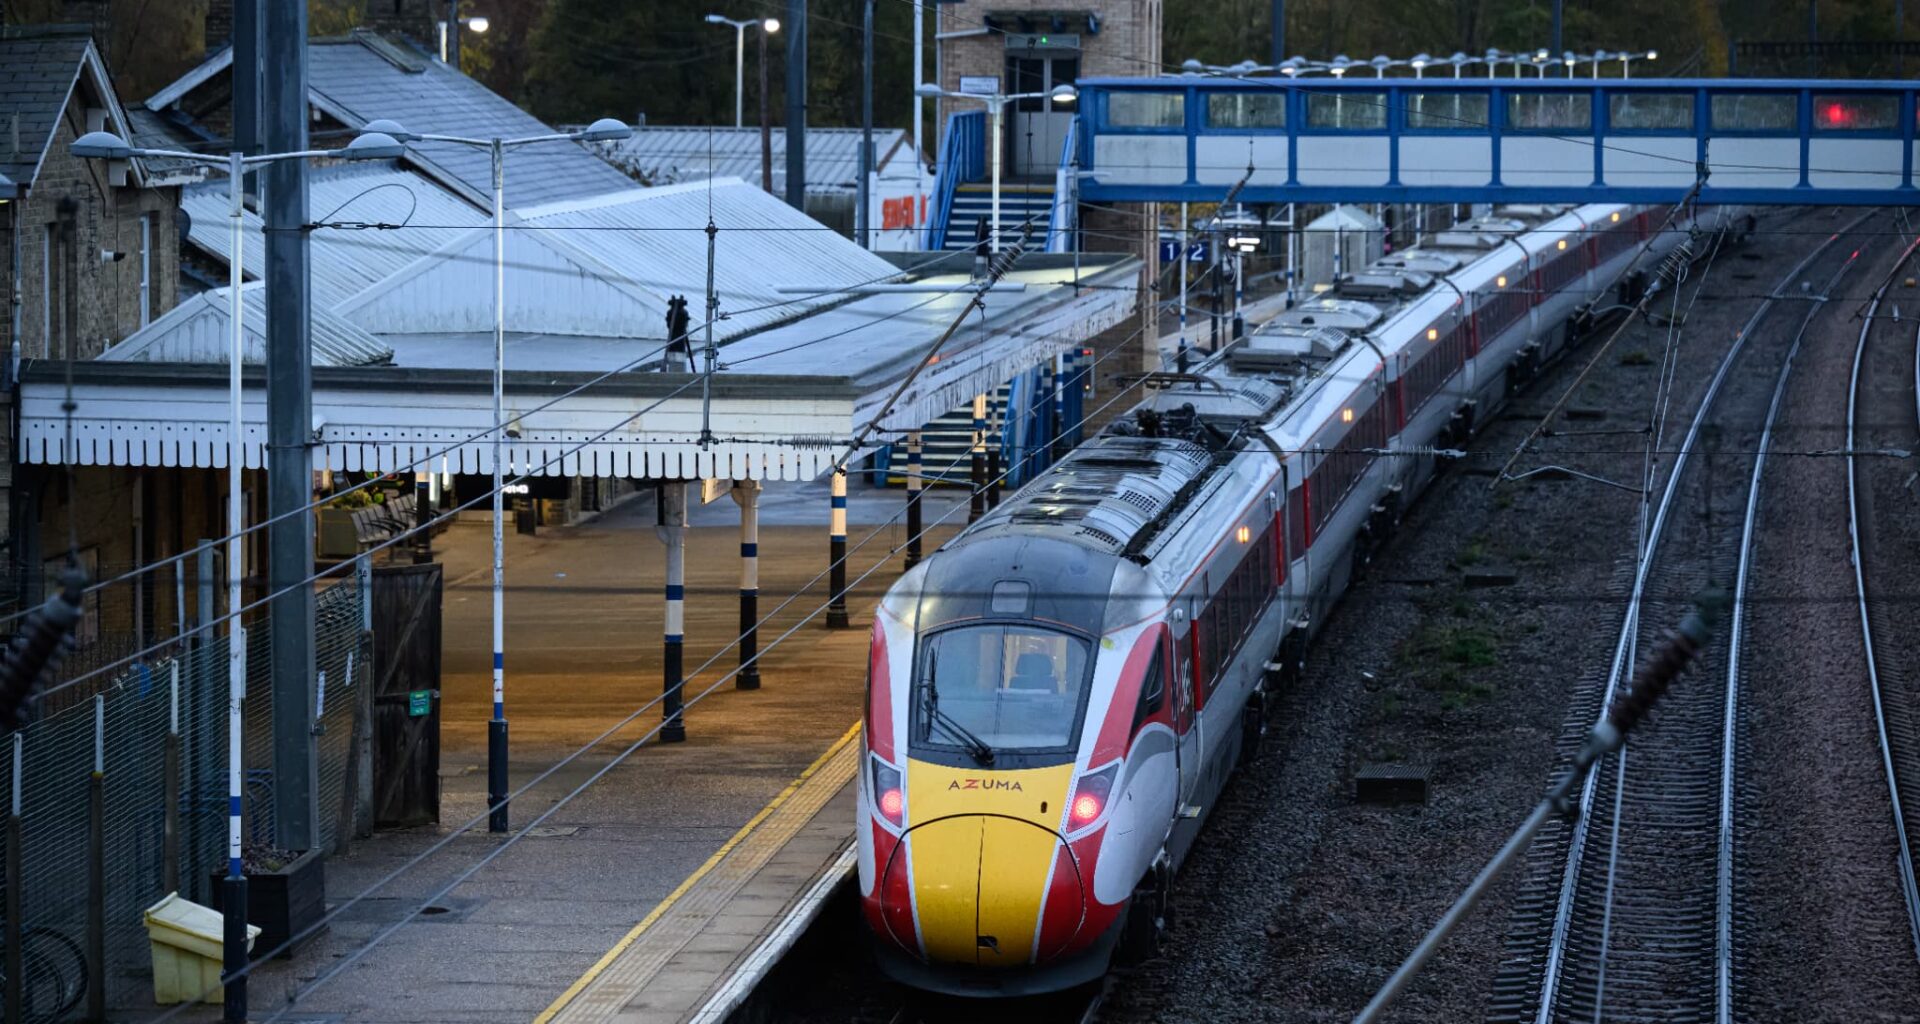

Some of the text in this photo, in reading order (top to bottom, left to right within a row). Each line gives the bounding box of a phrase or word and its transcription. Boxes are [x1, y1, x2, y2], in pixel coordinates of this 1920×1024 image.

[1167, 243, 1204, 261] 1 2
[948, 778, 1023, 792] AZUMA
